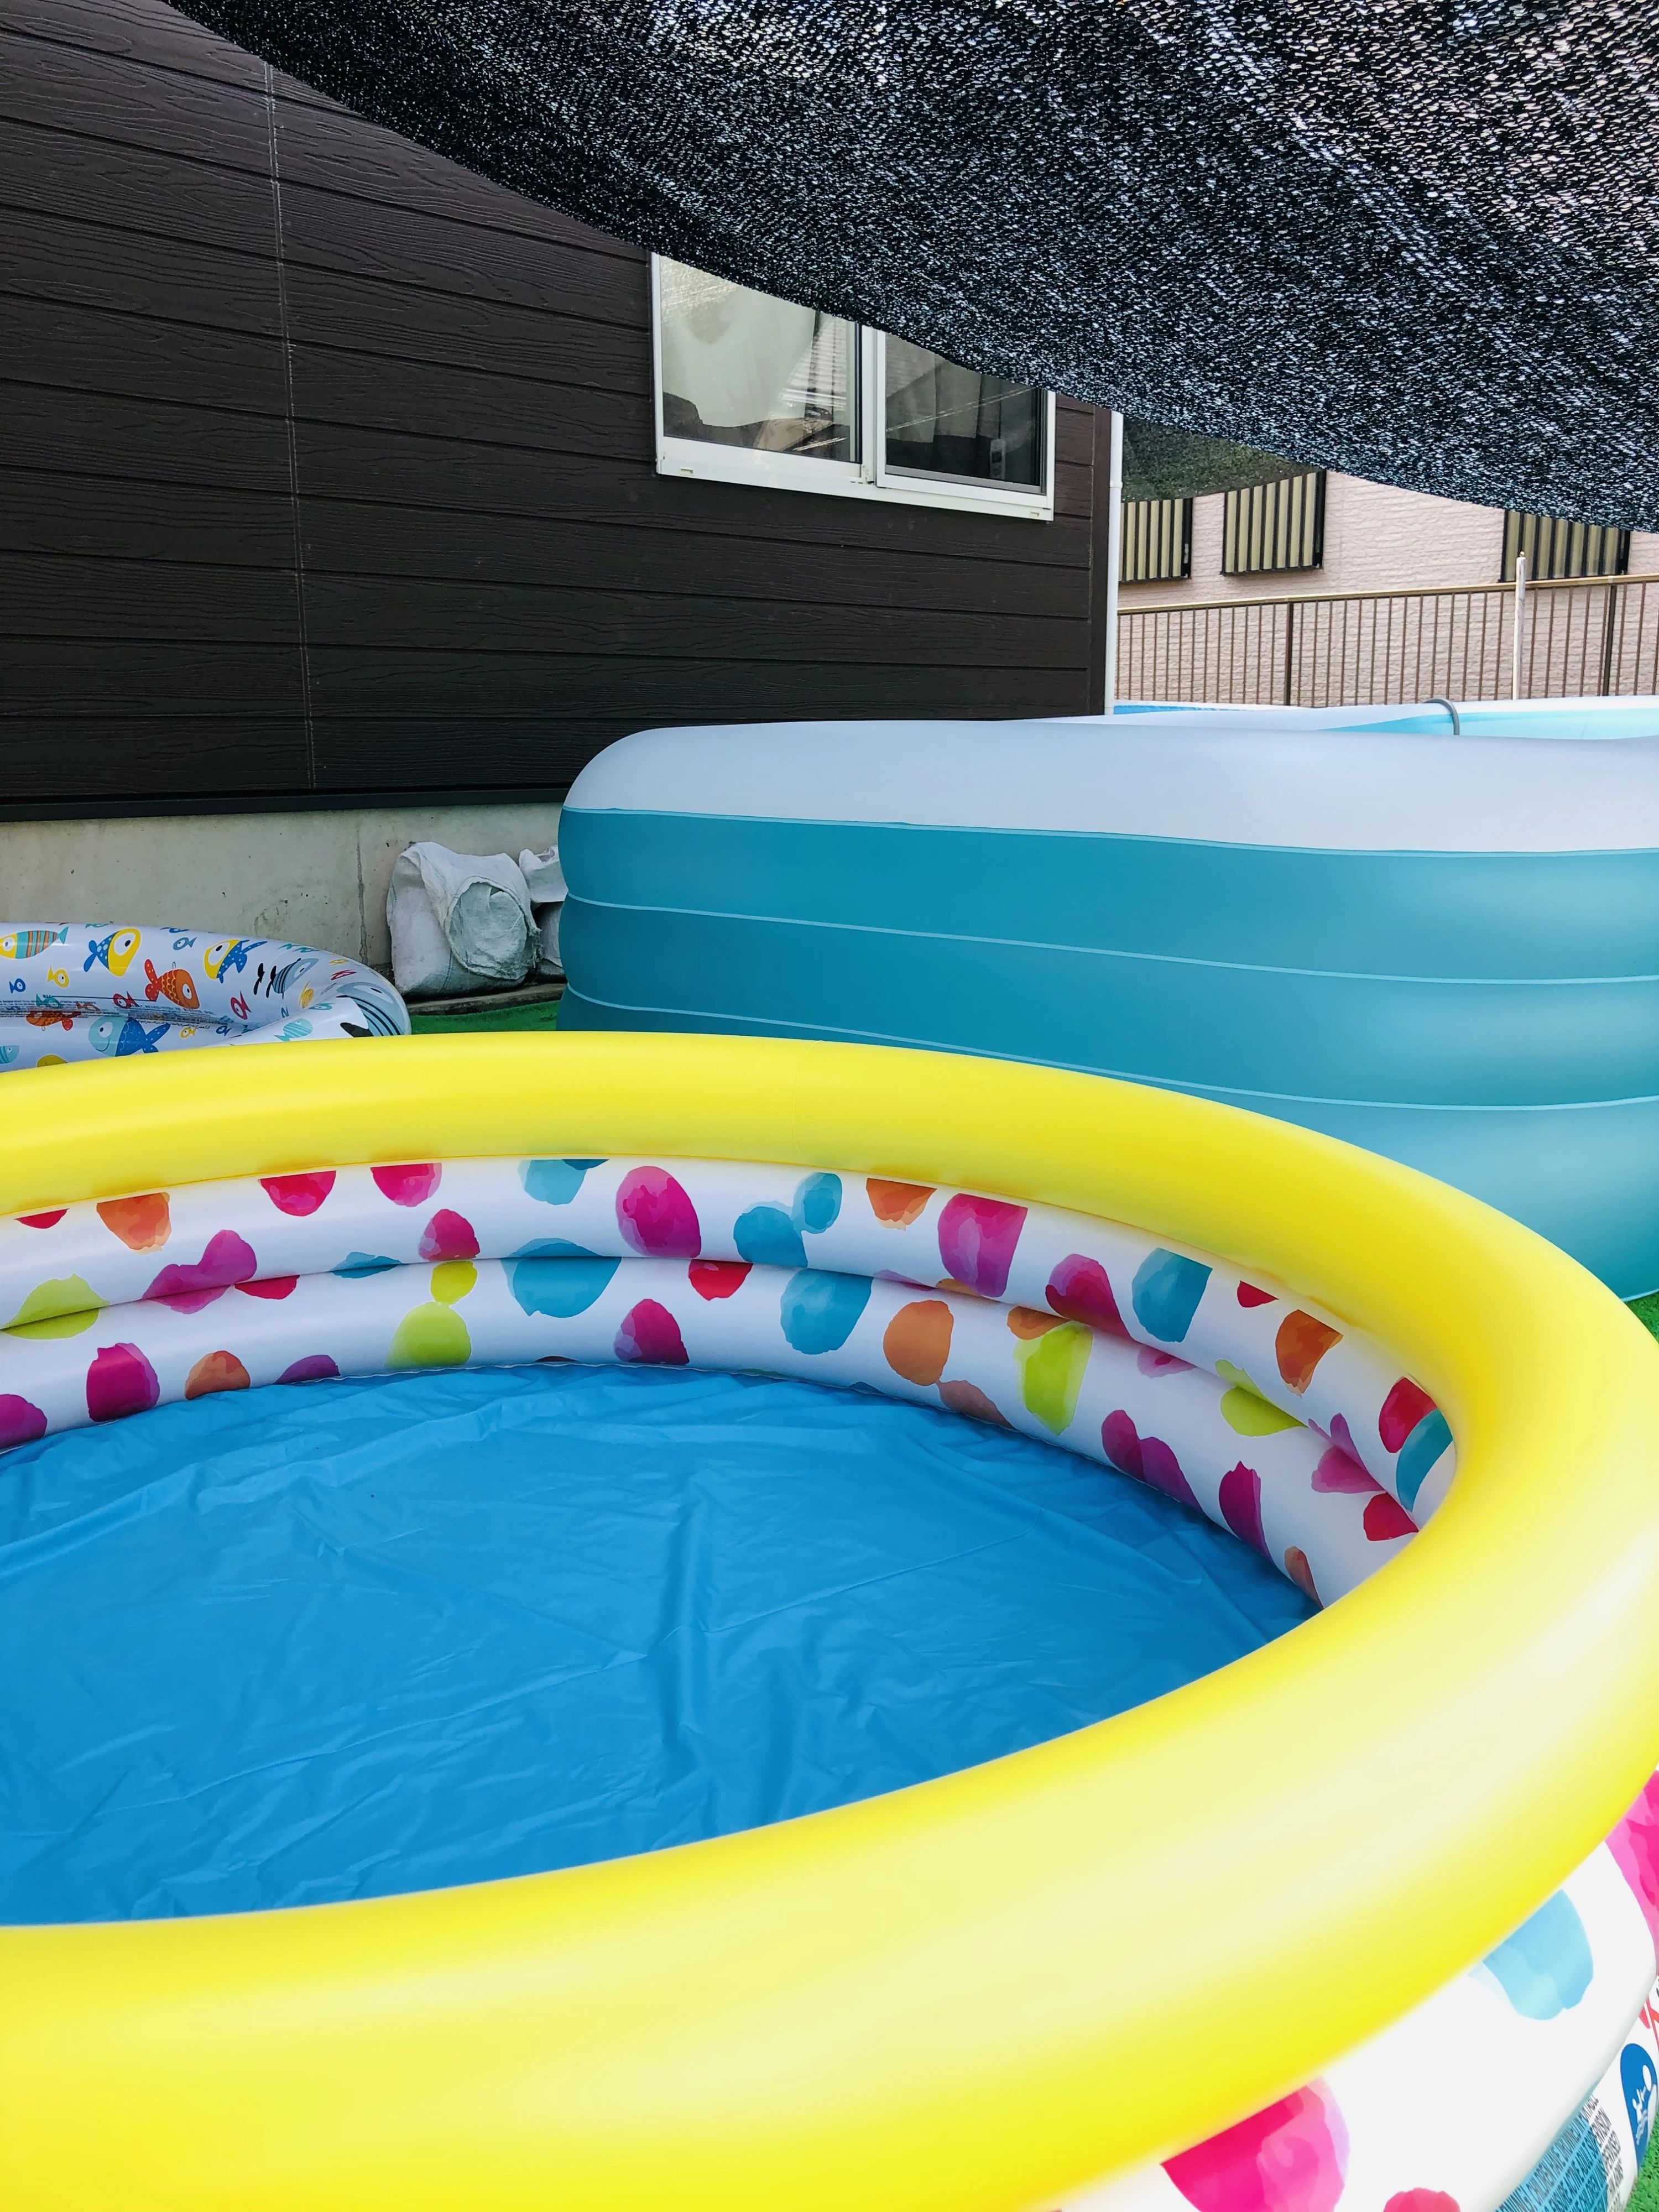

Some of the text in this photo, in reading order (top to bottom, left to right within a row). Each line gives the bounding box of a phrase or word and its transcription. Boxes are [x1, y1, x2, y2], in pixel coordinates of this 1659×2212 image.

[1584, 2105, 1612, 2158] SUPERVISION
[1526, 2160, 1557, 2206] CHILDREN
[1543, 2146, 1566, 2177] HAVE
[1563, 2160, 1584, 2199] ACTIVE
[1575, 2141, 1594, 2178] ADULT
